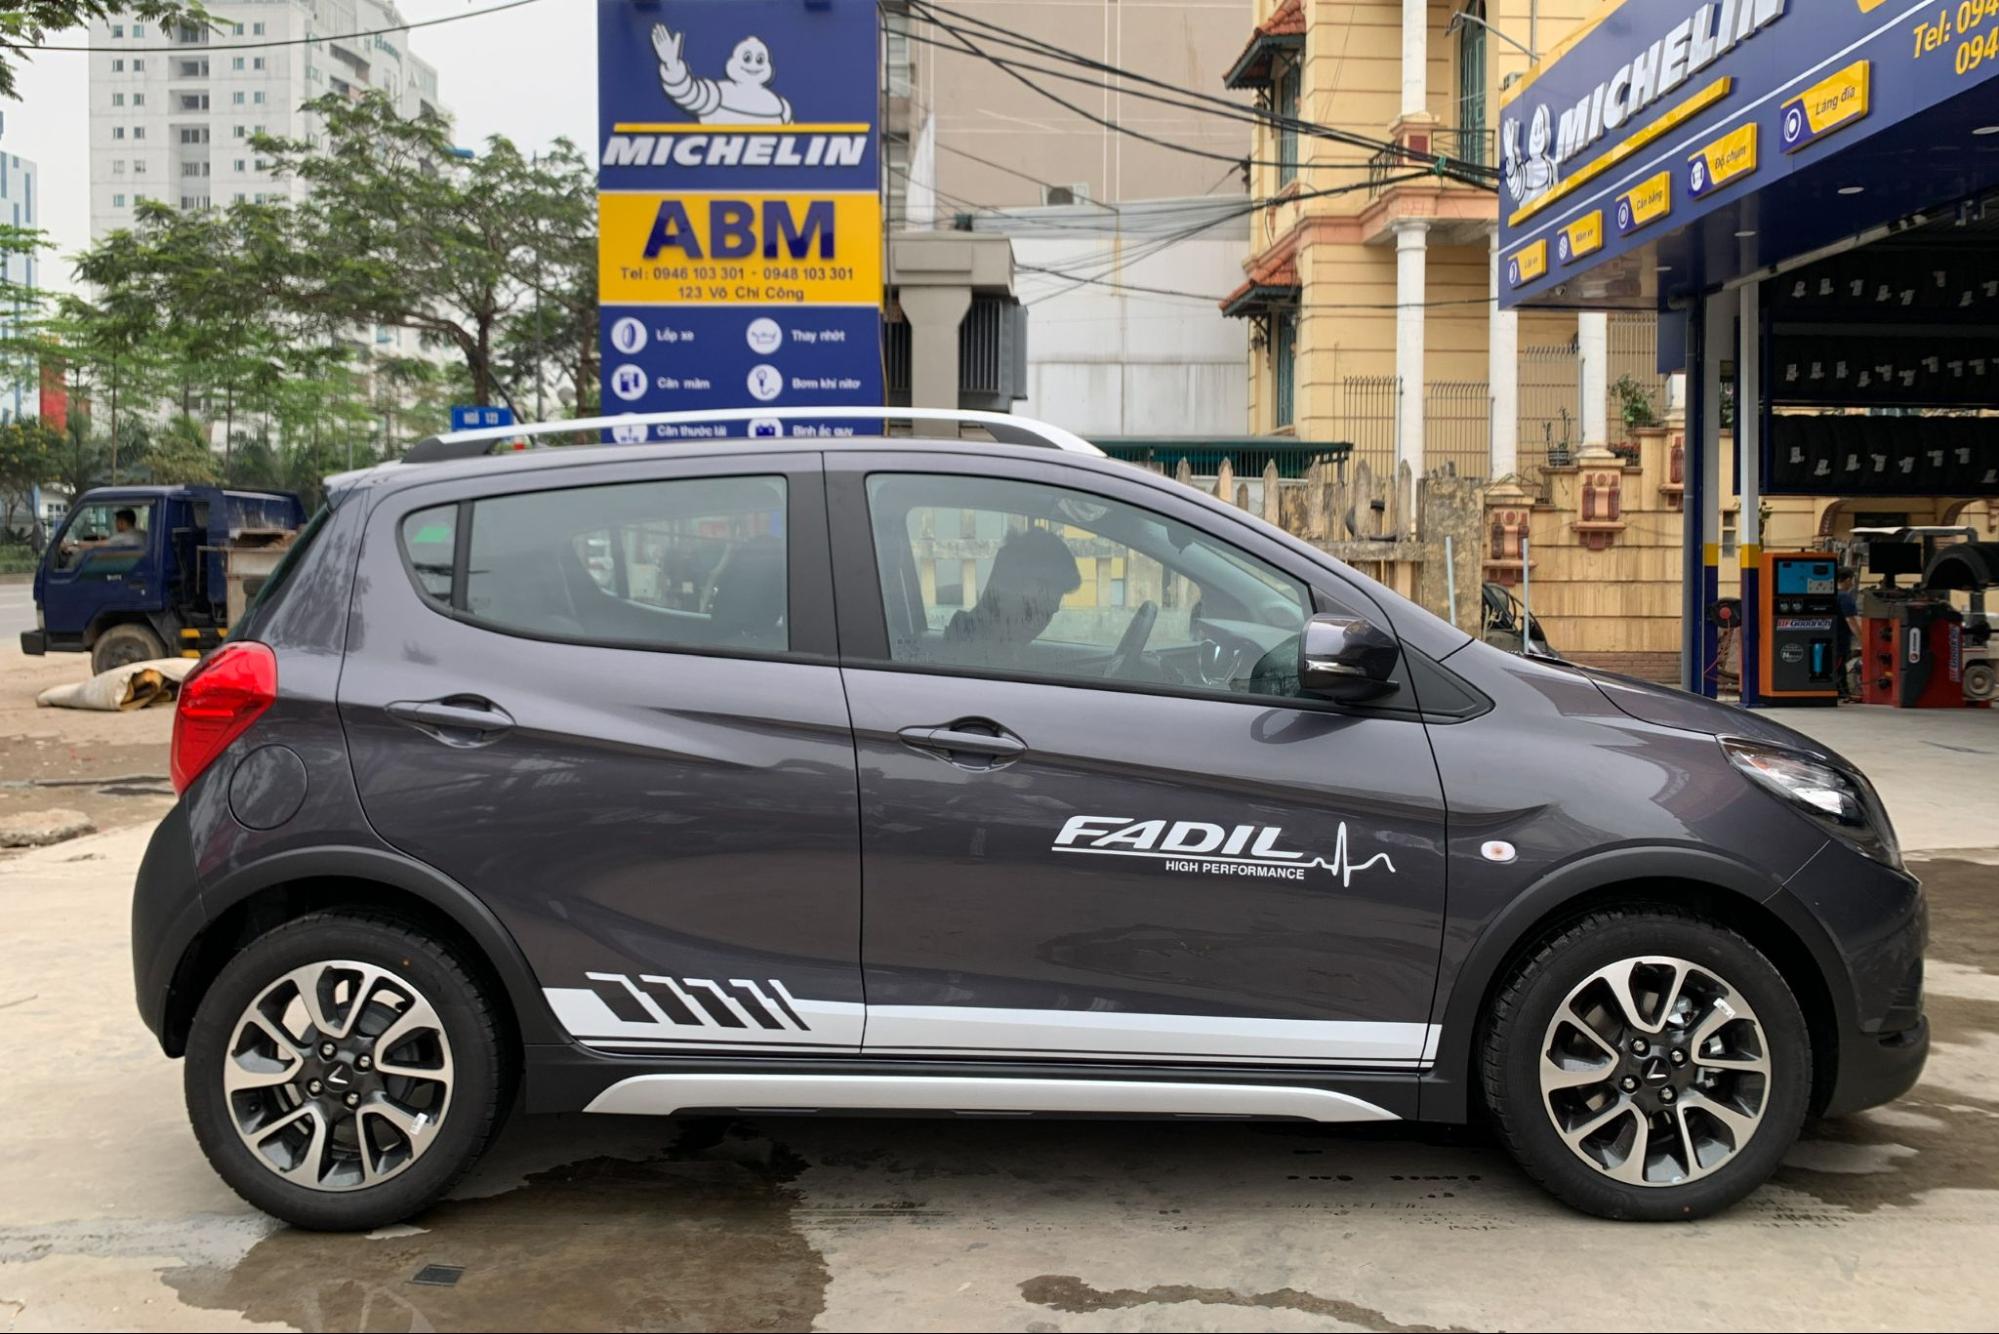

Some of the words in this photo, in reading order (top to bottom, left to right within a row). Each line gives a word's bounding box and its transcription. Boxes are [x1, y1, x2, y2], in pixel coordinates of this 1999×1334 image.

[1913, 9, 1952, 59] Tel:
[1954, 26, 1999, 75] 094
[602, 136, 867, 166] MICHELIN
[642, 200, 835, 260] ABM
[620, 267, 648, 280] Tel:
[694, 267, 717, 280] 103
[720, 267, 744, 280] 301
[763, 267, 798, 280] 0948
[804, 267, 826, 281] 103
[829, 267, 853, 281] 301
[679, 286, 703, 299] 123
[765, 286, 804, 303] Công
[680, 331, 695, 341] xe
[791, 329, 817, 344] Thay
[1053, 815, 1304, 859] FADIL
[1165, 860, 1199, 873] HIGH
[1202, 862, 1305, 880] PERFORMANCE
